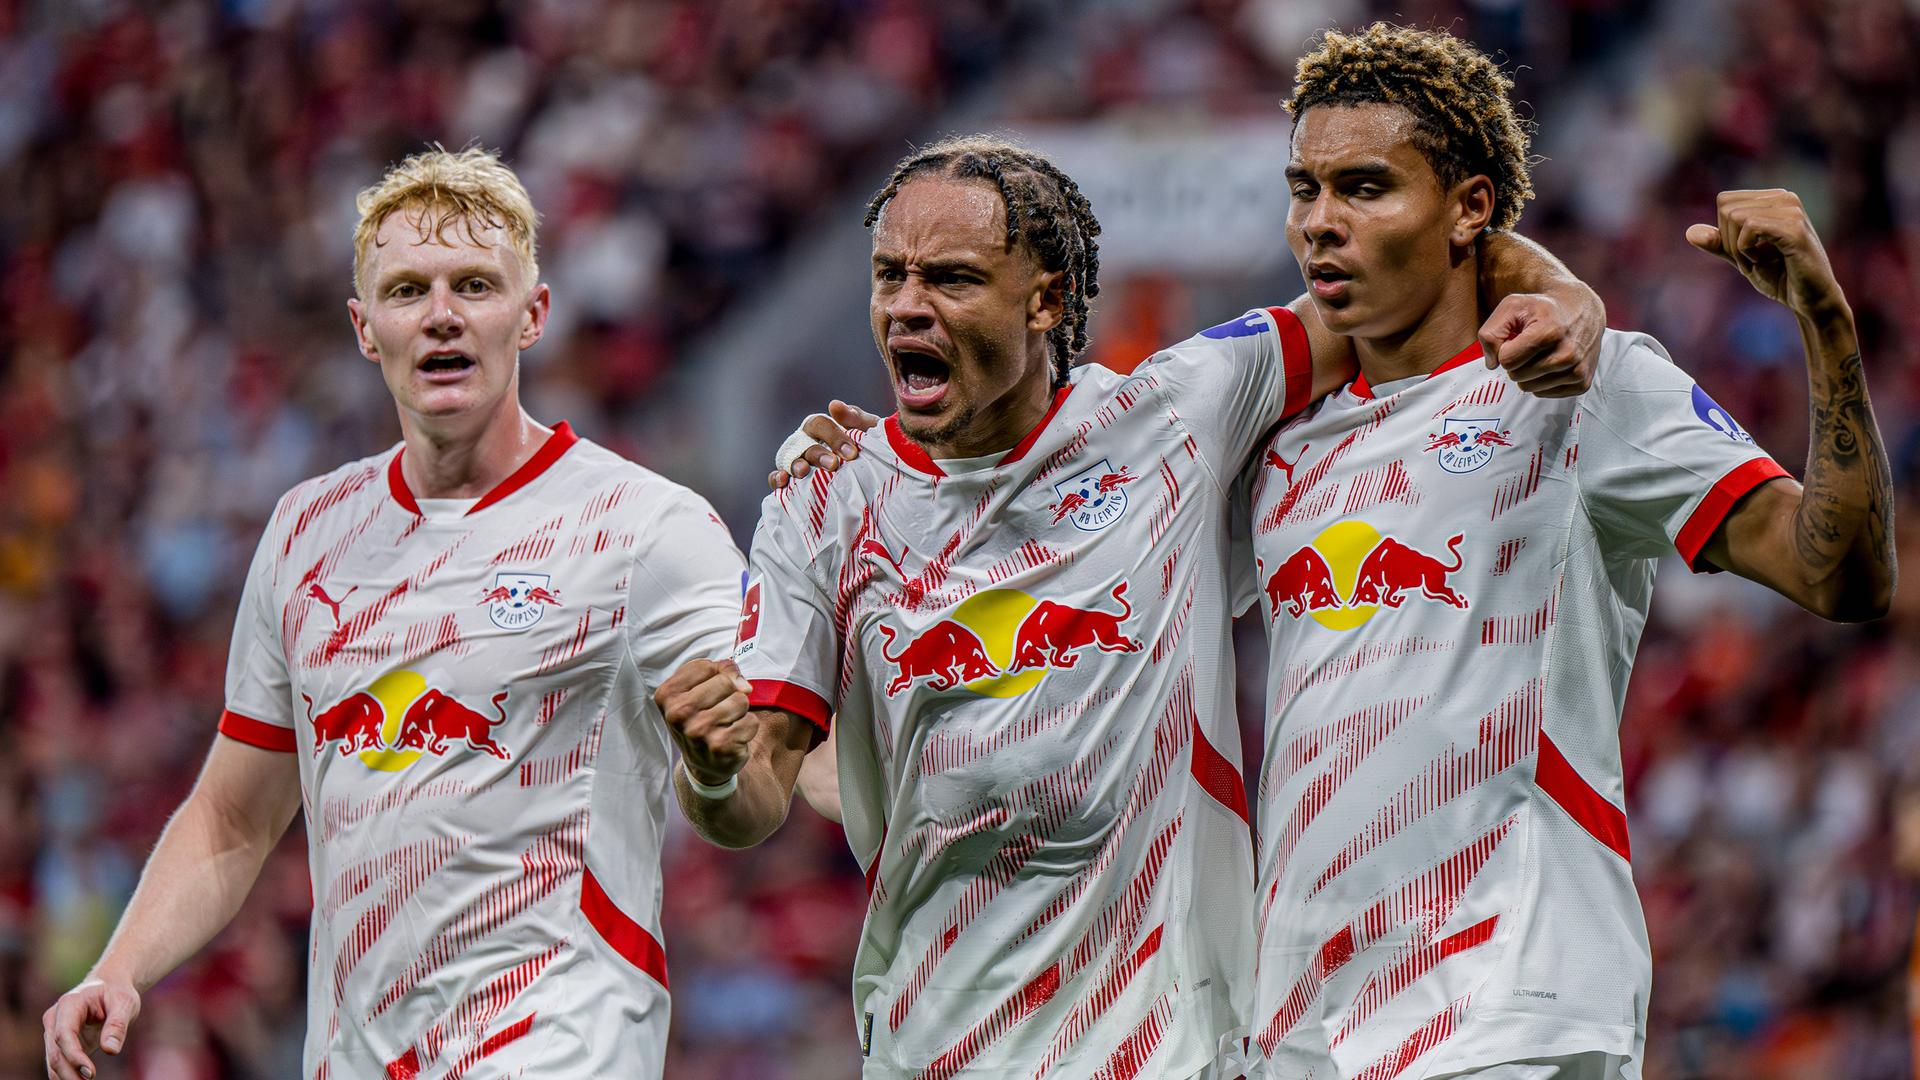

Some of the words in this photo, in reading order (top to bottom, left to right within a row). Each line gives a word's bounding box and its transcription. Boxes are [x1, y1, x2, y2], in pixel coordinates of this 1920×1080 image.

[1452, 449, 1488, 468] LEIPZIG
[1078, 511, 1091, 525] RB
[1093, 495, 1122, 525] LEIPZIG
[504, 607, 539, 624] LEIPZIG
[1512, 989, 1558, 1000] ULTRAWEAVE
